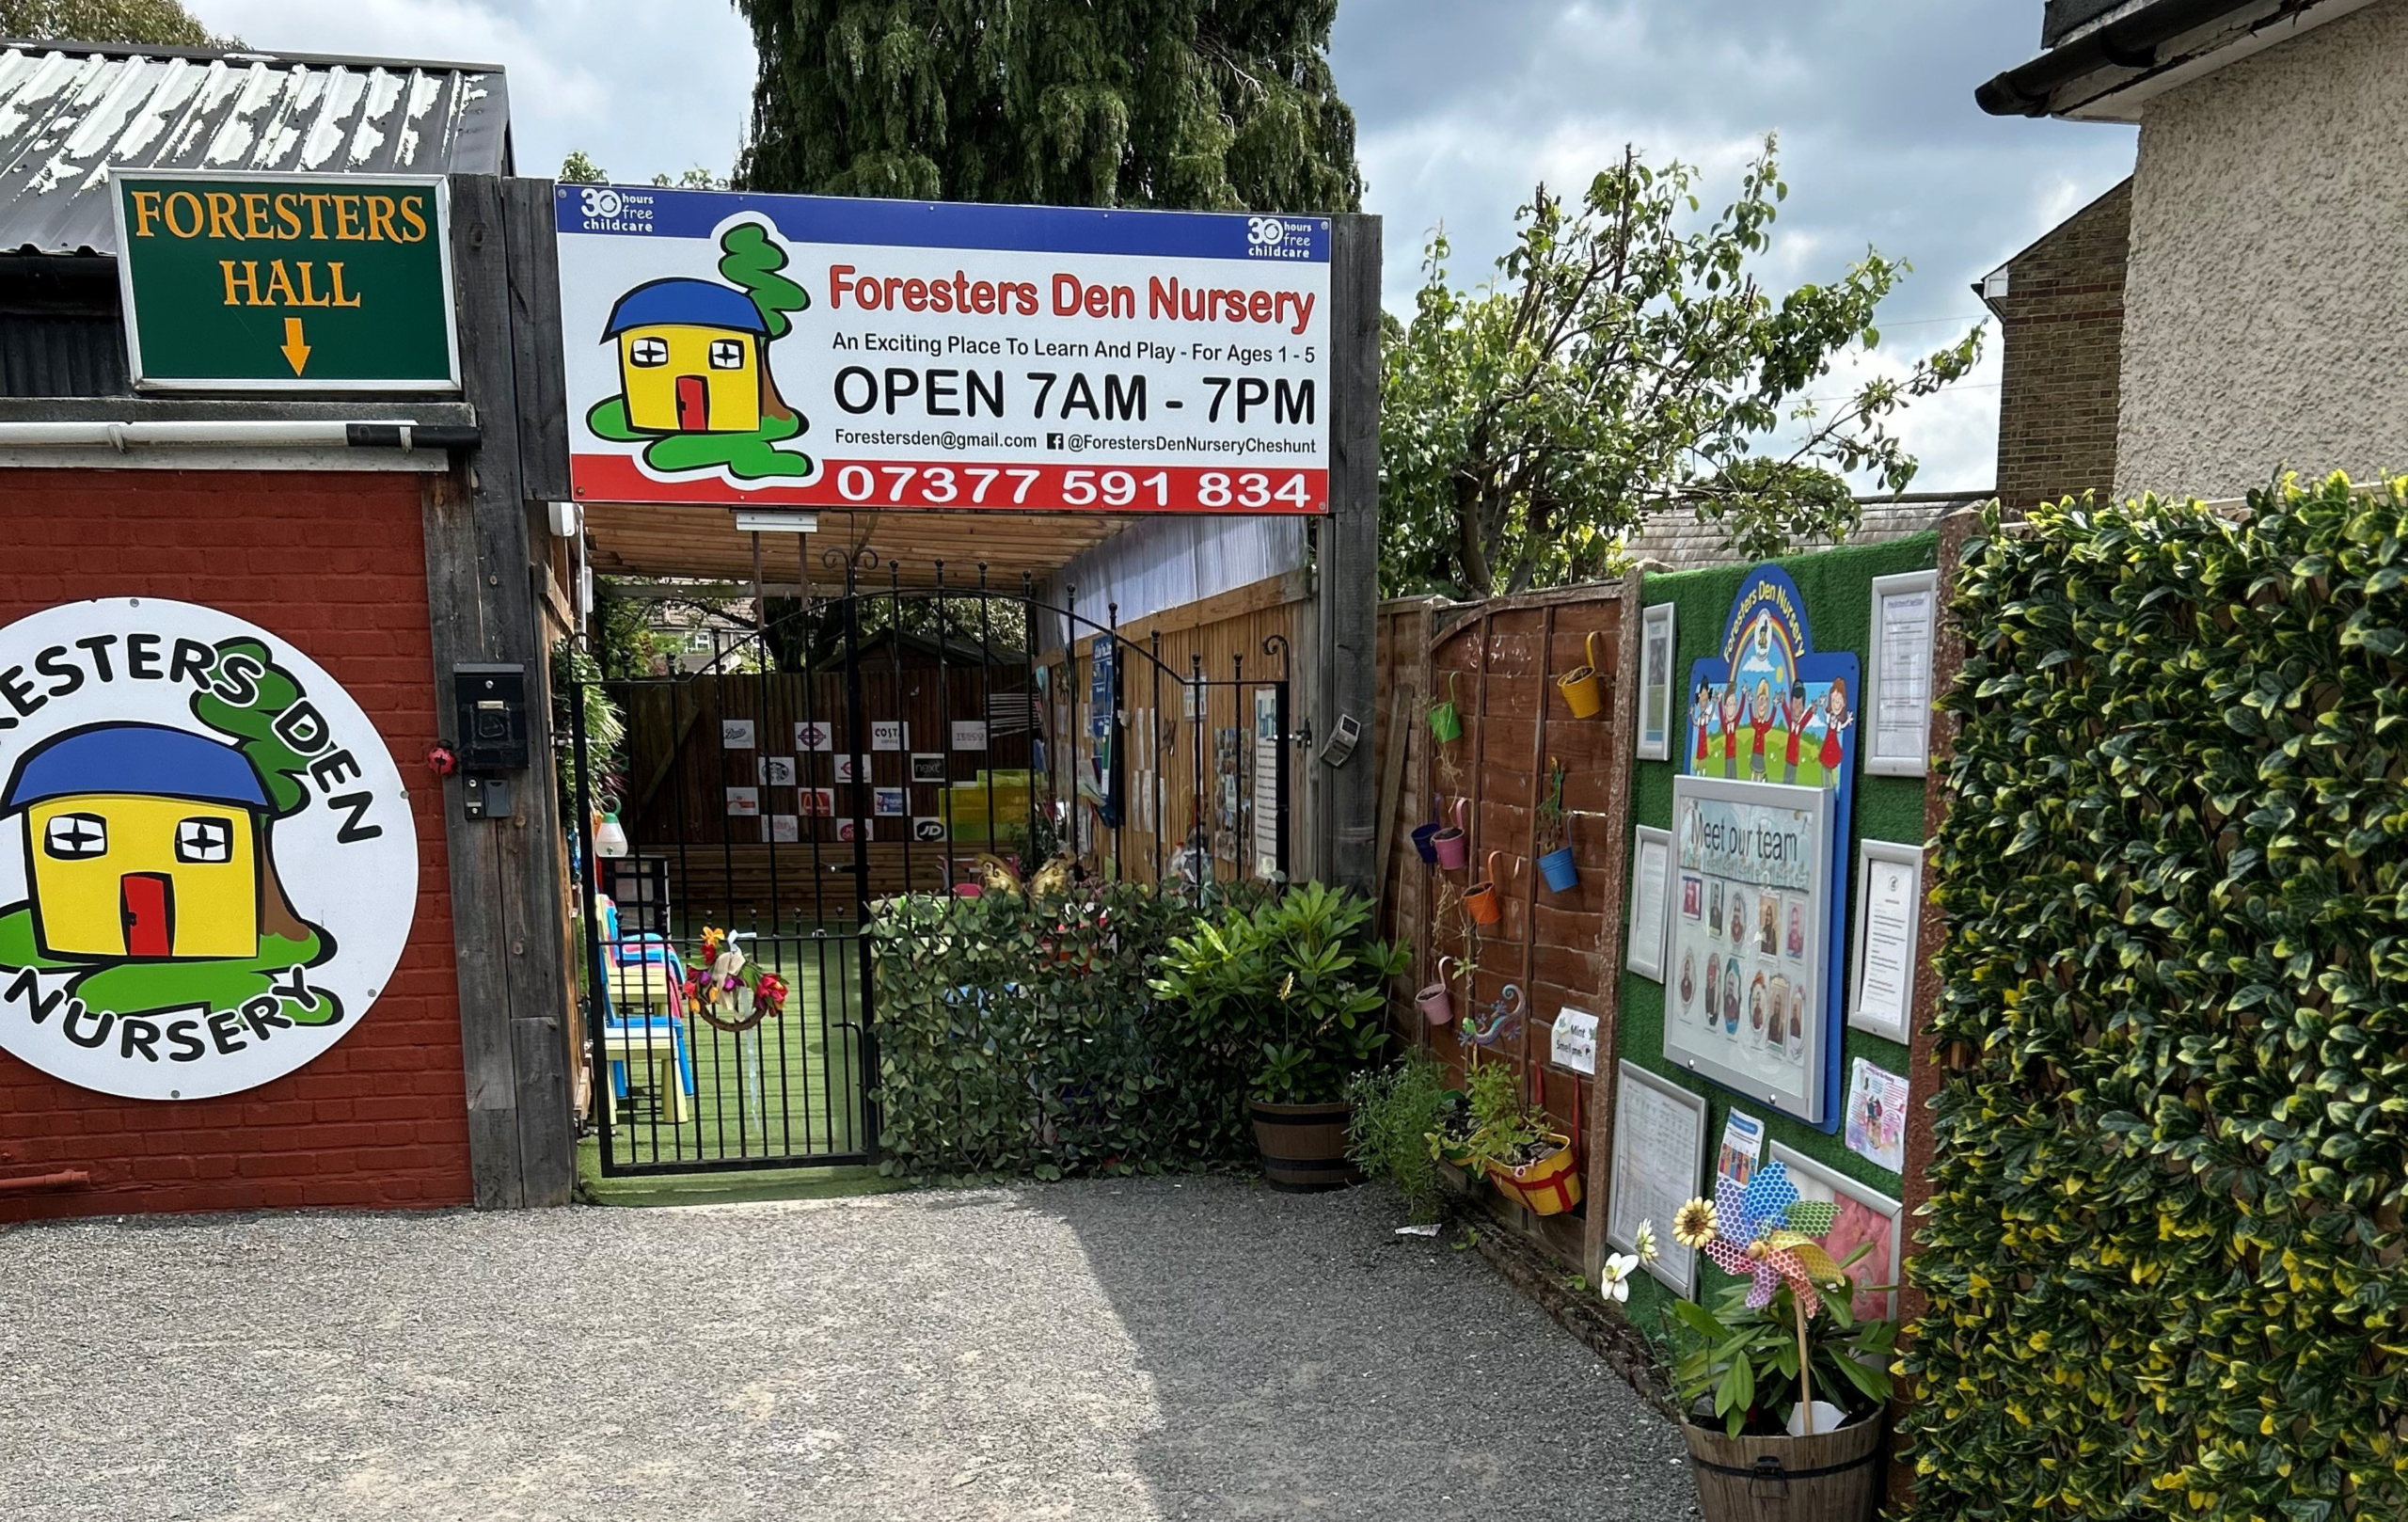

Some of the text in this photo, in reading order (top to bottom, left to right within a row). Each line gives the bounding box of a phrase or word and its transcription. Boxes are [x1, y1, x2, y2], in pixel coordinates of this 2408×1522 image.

[131, 190, 427, 243] FORESTERS
[580, 188, 654, 217] 30 hours
[623, 206, 654, 220] free
[583, 218, 653, 232] childcare
[1247, 217, 1312, 245] 30 hours
[1284, 232, 1311, 246] free
[1248, 246, 1310, 259] childcare
[219, 258, 361, 309] HALL
[830, 264, 1315, 335] Foresters Den Nursery
[832, 332, 859, 350] An
[864, 333, 942, 357] Exciting
[947, 336, 1001, 355] Place
[1006, 338, 1029, 356] To
[1035, 339, 1088, 357] Learn
[1094, 341, 1131, 359] And
[1137, 341, 1176, 363] Play
[1192, 343, 1222, 361] For
[1227, 344, 1272, 366] Ages
[1278, 346, 1287, 363] 1
[1305, 347, 1315, 363] 5
[833, 365, 1315, 425] OPEN 7AM - 7PM
[835, 429, 1037, 451] Forestersden@gmail.com
[1068, 434, 1317, 455] @ForestersDenNurseryCheshunt
[837, 465, 1311, 508] 07377 591 834
[1723, 589, 1757, 663] Foresters
[1758, 580, 1776, 601] Den
[1776, 584, 1805, 658] Nursery
[875, 728, 900, 738] COST
[956, 732, 985, 741] TESCO
[273, 697, 383, 844] DEN
[920, 825, 943, 836] JD
[1691, 810, 1798, 863] Meet our team
[4, 966, 319, 1063] NURSERY
